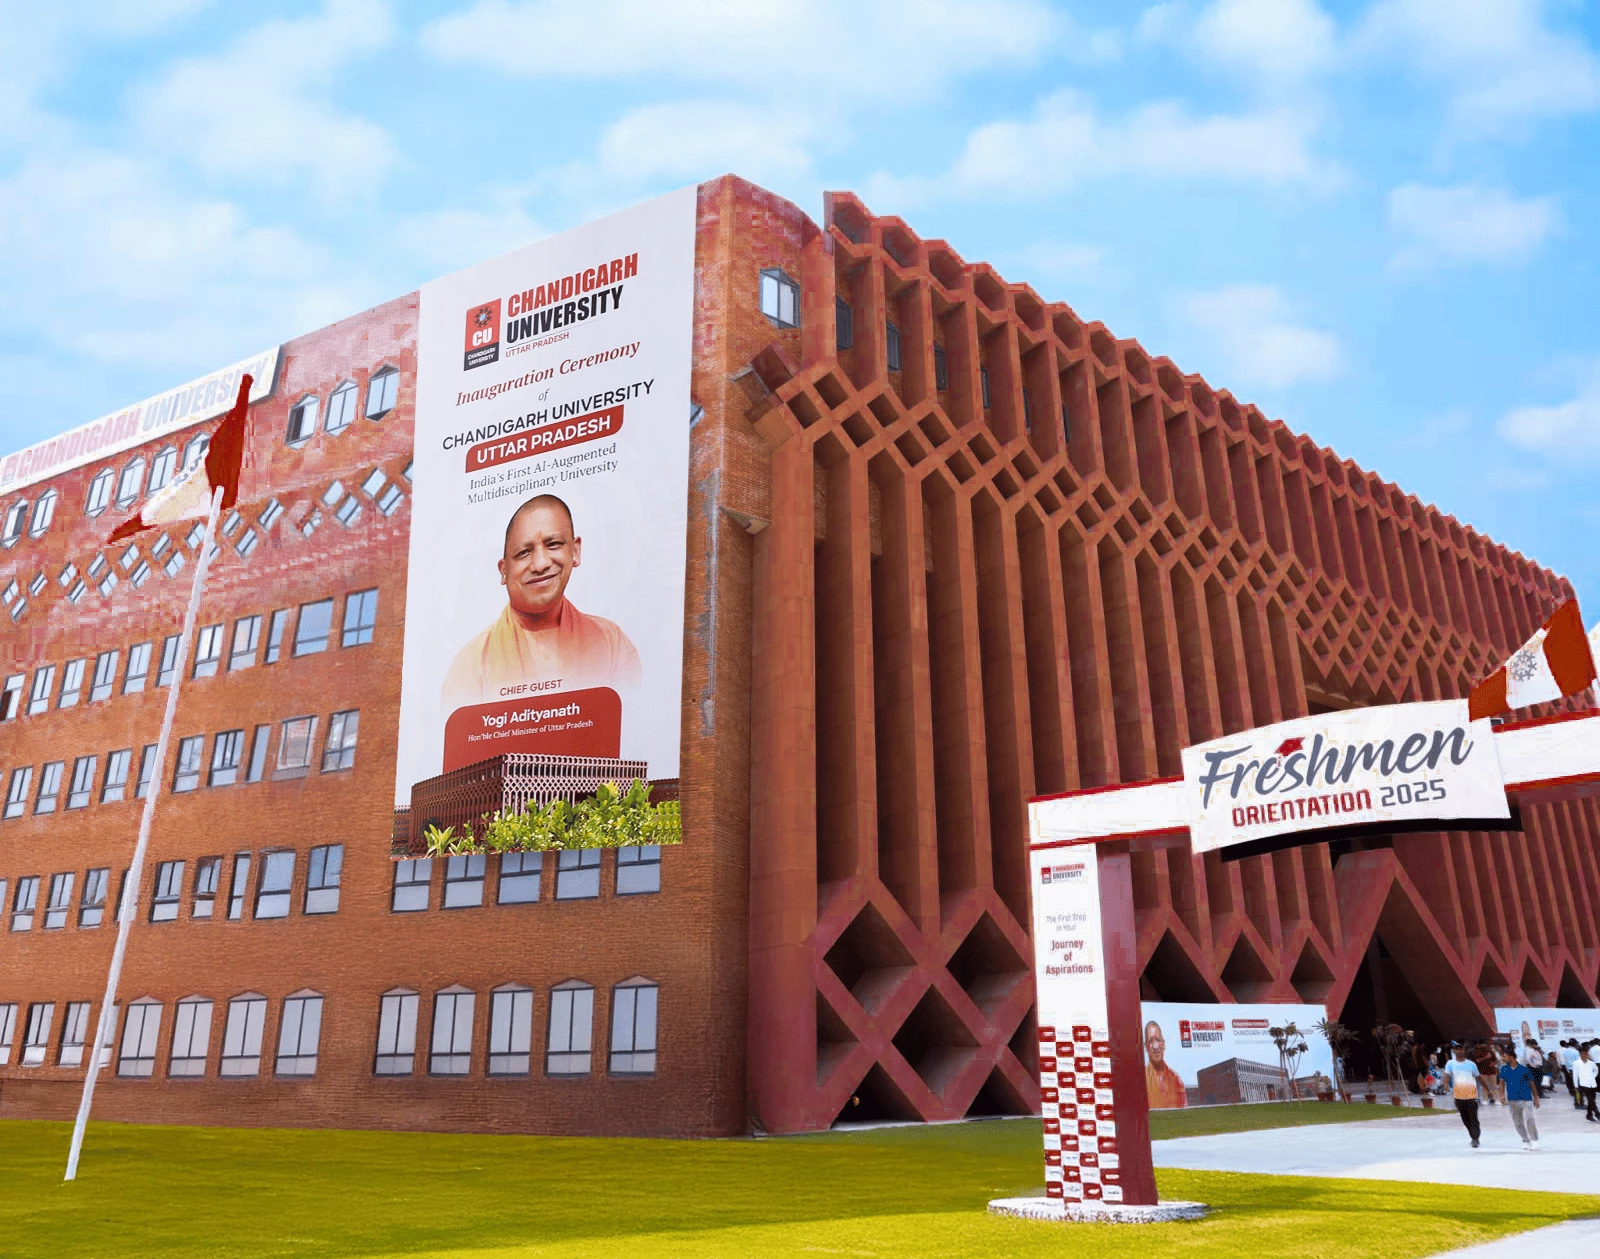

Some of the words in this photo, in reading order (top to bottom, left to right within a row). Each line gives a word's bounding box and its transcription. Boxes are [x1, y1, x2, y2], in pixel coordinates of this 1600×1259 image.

[508, 252, 638, 317] CHANDIGARH
[506, 285, 624, 344] UNIVERSITY
[472, 327, 493, 347] CU
[505, 344, 531, 358] UTTAR
[533, 331, 569, 350] PRADESH
[455, 367, 555, 407] Inauguration
[560, 340, 641, 376] Ceremony
[538, 388, 550, 402] of
[442, 409, 548, 451] CHANDIGARH
[552, 378, 655, 420] UNIVERSITY
[476, 437, 528, 464] UTTAR
[531, 415, 612, 450] PRADESH
[467, 474, 558, 506] Multidisciplinary
[560, 458, 618, 482] University
[469, 472, 505, 490] India's
[507, 465, 531, 482] First
[534, 442, 617, 474] AI-Augmented
[499, 683, 528, 696] CHIEF
[530, 679, 563, 692] GUEST
[482, 712, 508, 728] Yogi
[510, 702, 580, 723] Adityanath
[493, 730, 511, 739] Chief
[511, 726, 539, 737] Minister
[539, 724, 548, 733] of
[548, 723, 565, 732] Uttar
[566, 719, 594, 730] Pradesh
[1199, 726, 1474, 810] Freshmen
[1231, 788, 1373, 828] ORIENTATION
[1380, 778, 1447, 808] 2025
[1051, 940, 1084, 952] Journey
[1063, 952, 1073, 961] of
[1045, 963, 1094, 976] Aspirations
